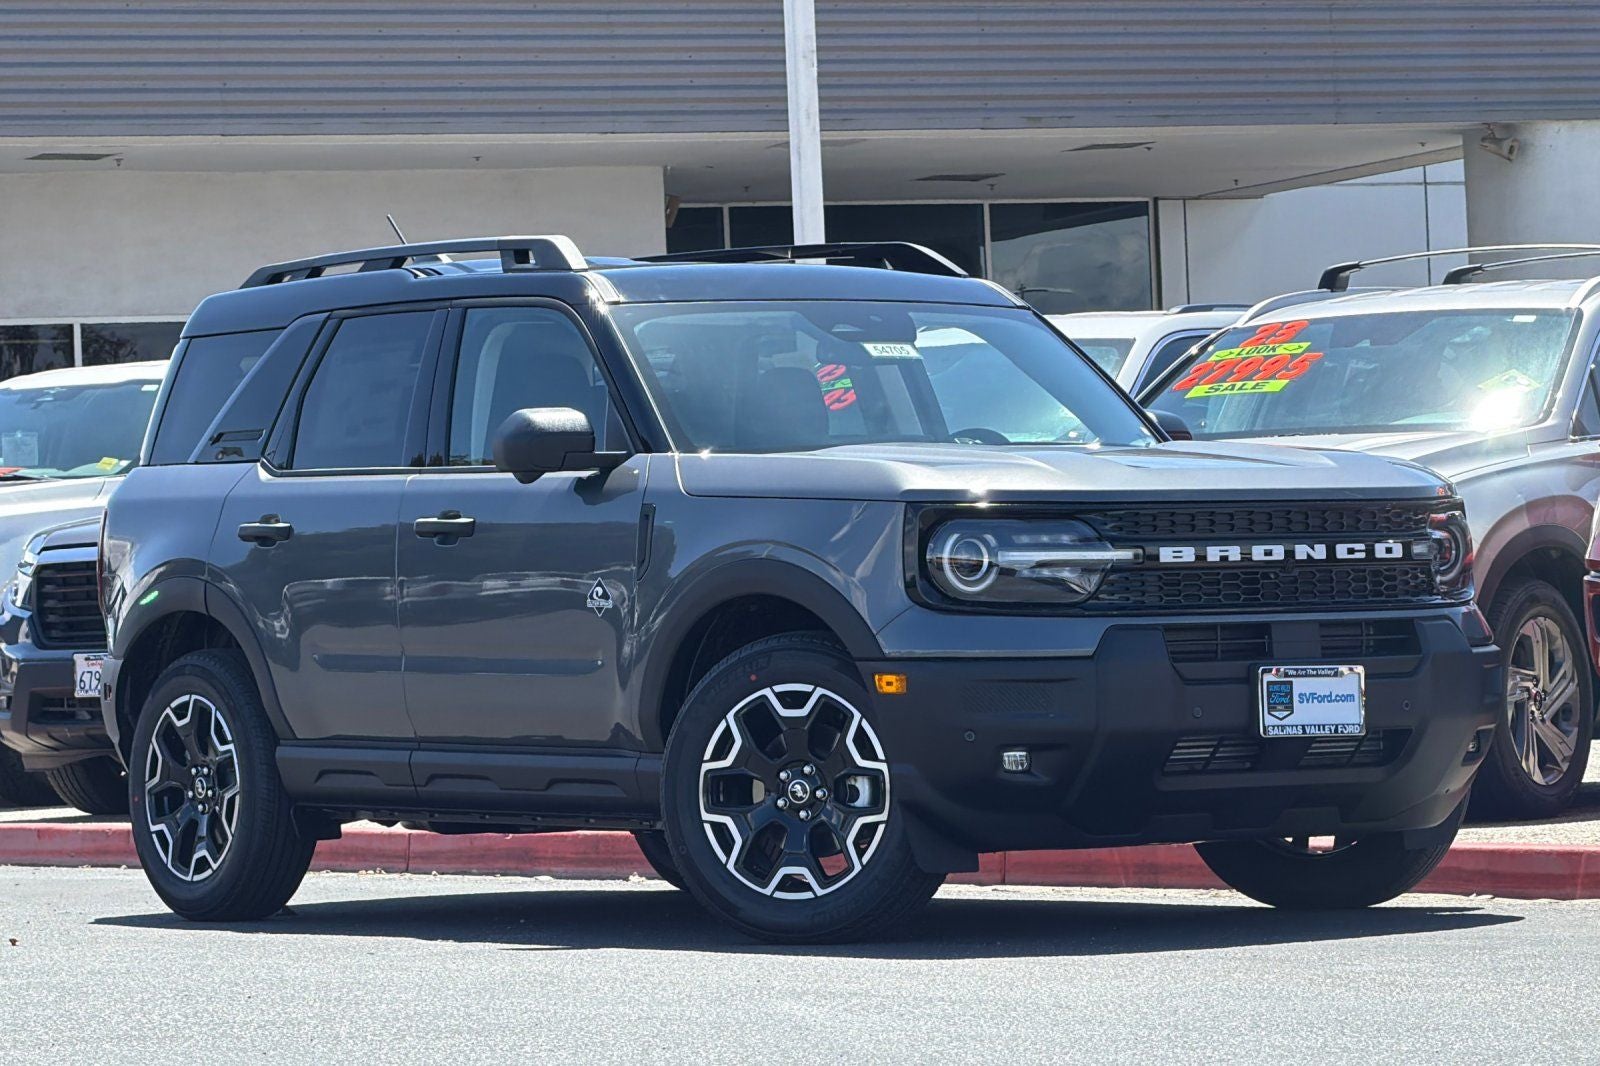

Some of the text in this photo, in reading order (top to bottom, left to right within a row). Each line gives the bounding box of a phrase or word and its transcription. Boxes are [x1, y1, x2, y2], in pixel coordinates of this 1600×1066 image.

[1239, 320, 1310, 348] 23
[873, 345, 910, 355] 54705
[1235, 345, 1281, 357] LOOK
[1172, 353, 1324, 391] 27995
[1204, 381, 1271, 394] SALE
[1159, 542, 1403, 563] BRONCO
[1306, 668, 1317, 676] The
[1269, 691, 1291, 704] Ford
[1297, 691, 1356, 704] SVFord.com
[1268, 724, 1360, 736] SALINAS VALLEY FORD
